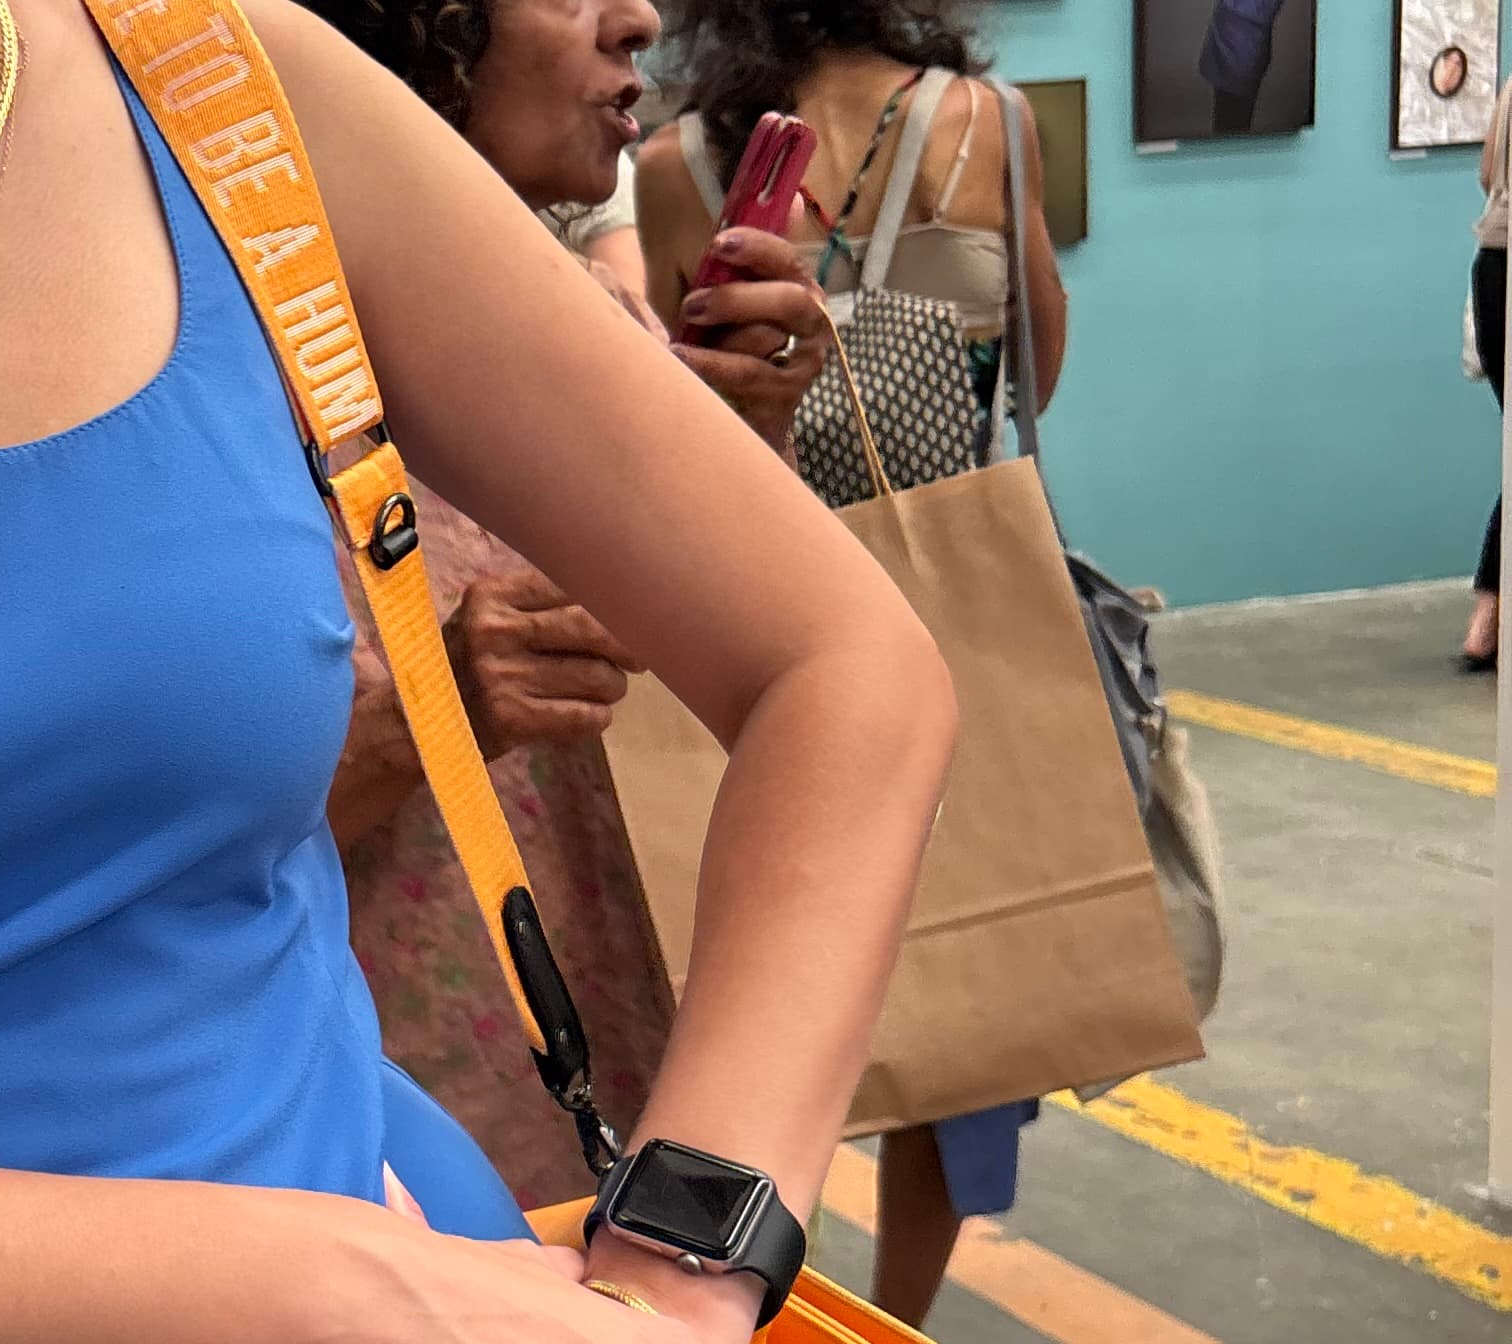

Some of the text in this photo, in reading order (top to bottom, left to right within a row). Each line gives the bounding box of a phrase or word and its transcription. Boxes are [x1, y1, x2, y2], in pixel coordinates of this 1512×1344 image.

[143, 12, 251, 113] TO
[190, 110, 303, 209] BE
[240, 222, 321, 275] A
